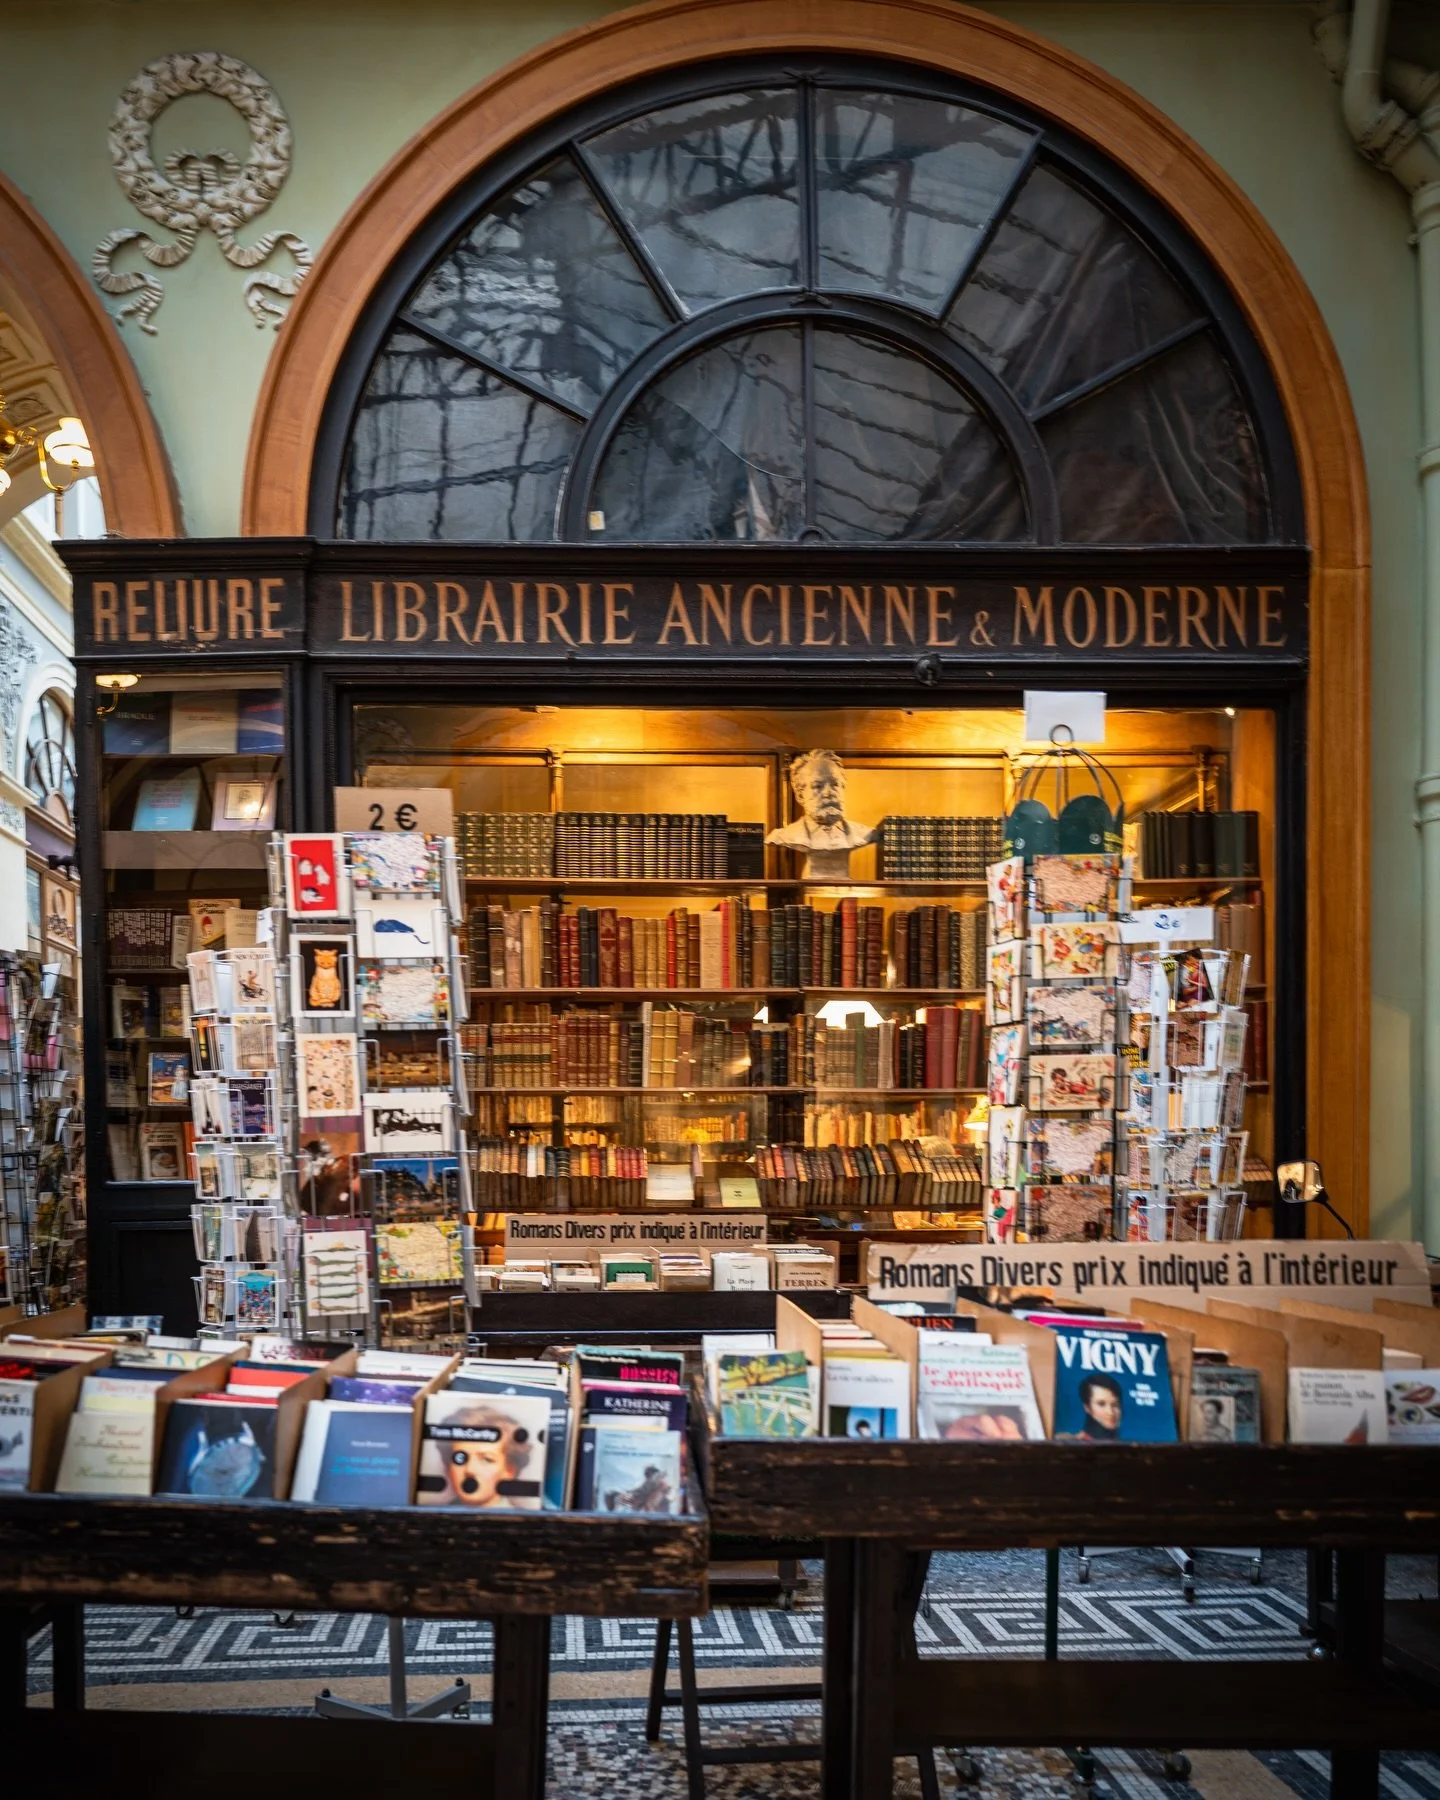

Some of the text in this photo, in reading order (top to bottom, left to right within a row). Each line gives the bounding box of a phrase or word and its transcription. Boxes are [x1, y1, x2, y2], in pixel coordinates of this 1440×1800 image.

[91, 578, 286, 642] RELIURE
[339, 579, 1289, 652] LIBRAIRIE ANCIENNE & MODERNE
[368, 803, 418, 831] 2 €
[510, 1220, 764, 1244] Romans Divers prix indiqué à l'intérieur
[879, 1250, 1399, 1294] Romans Divers prix indiqué à l'intérieur
[1056, 1335, 1161, 1377] VIGNY
[604, 1396, 673, 1412] KATHERINE
